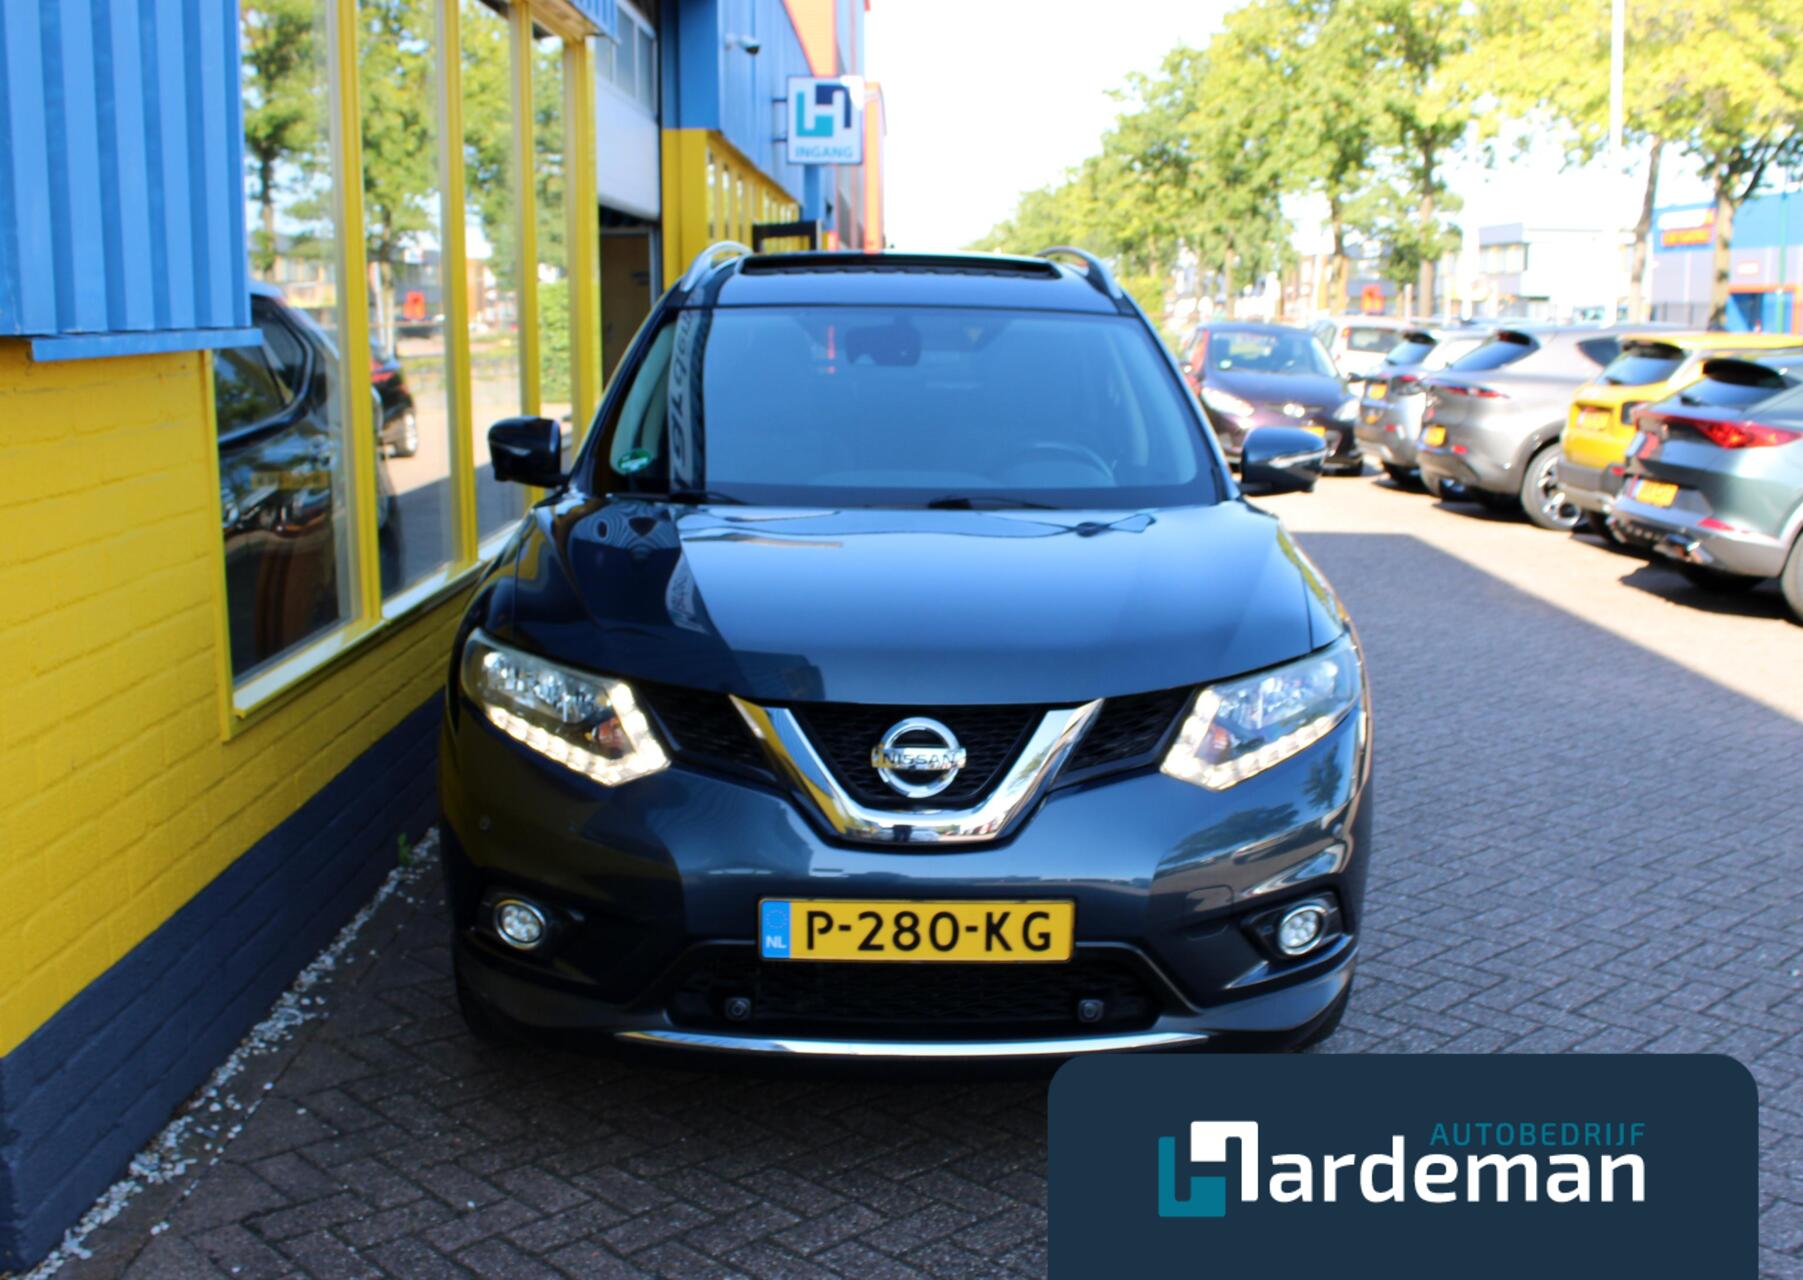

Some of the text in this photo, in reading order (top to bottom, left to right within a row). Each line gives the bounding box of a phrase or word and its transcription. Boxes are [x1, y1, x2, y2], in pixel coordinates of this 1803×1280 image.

[795, 146, 853, 158] INGANG
[883, 753, 956, 766] NISSAN
[806, 911, 1051, 951] P-280-KG
[766, 935, 786, 949] NL
